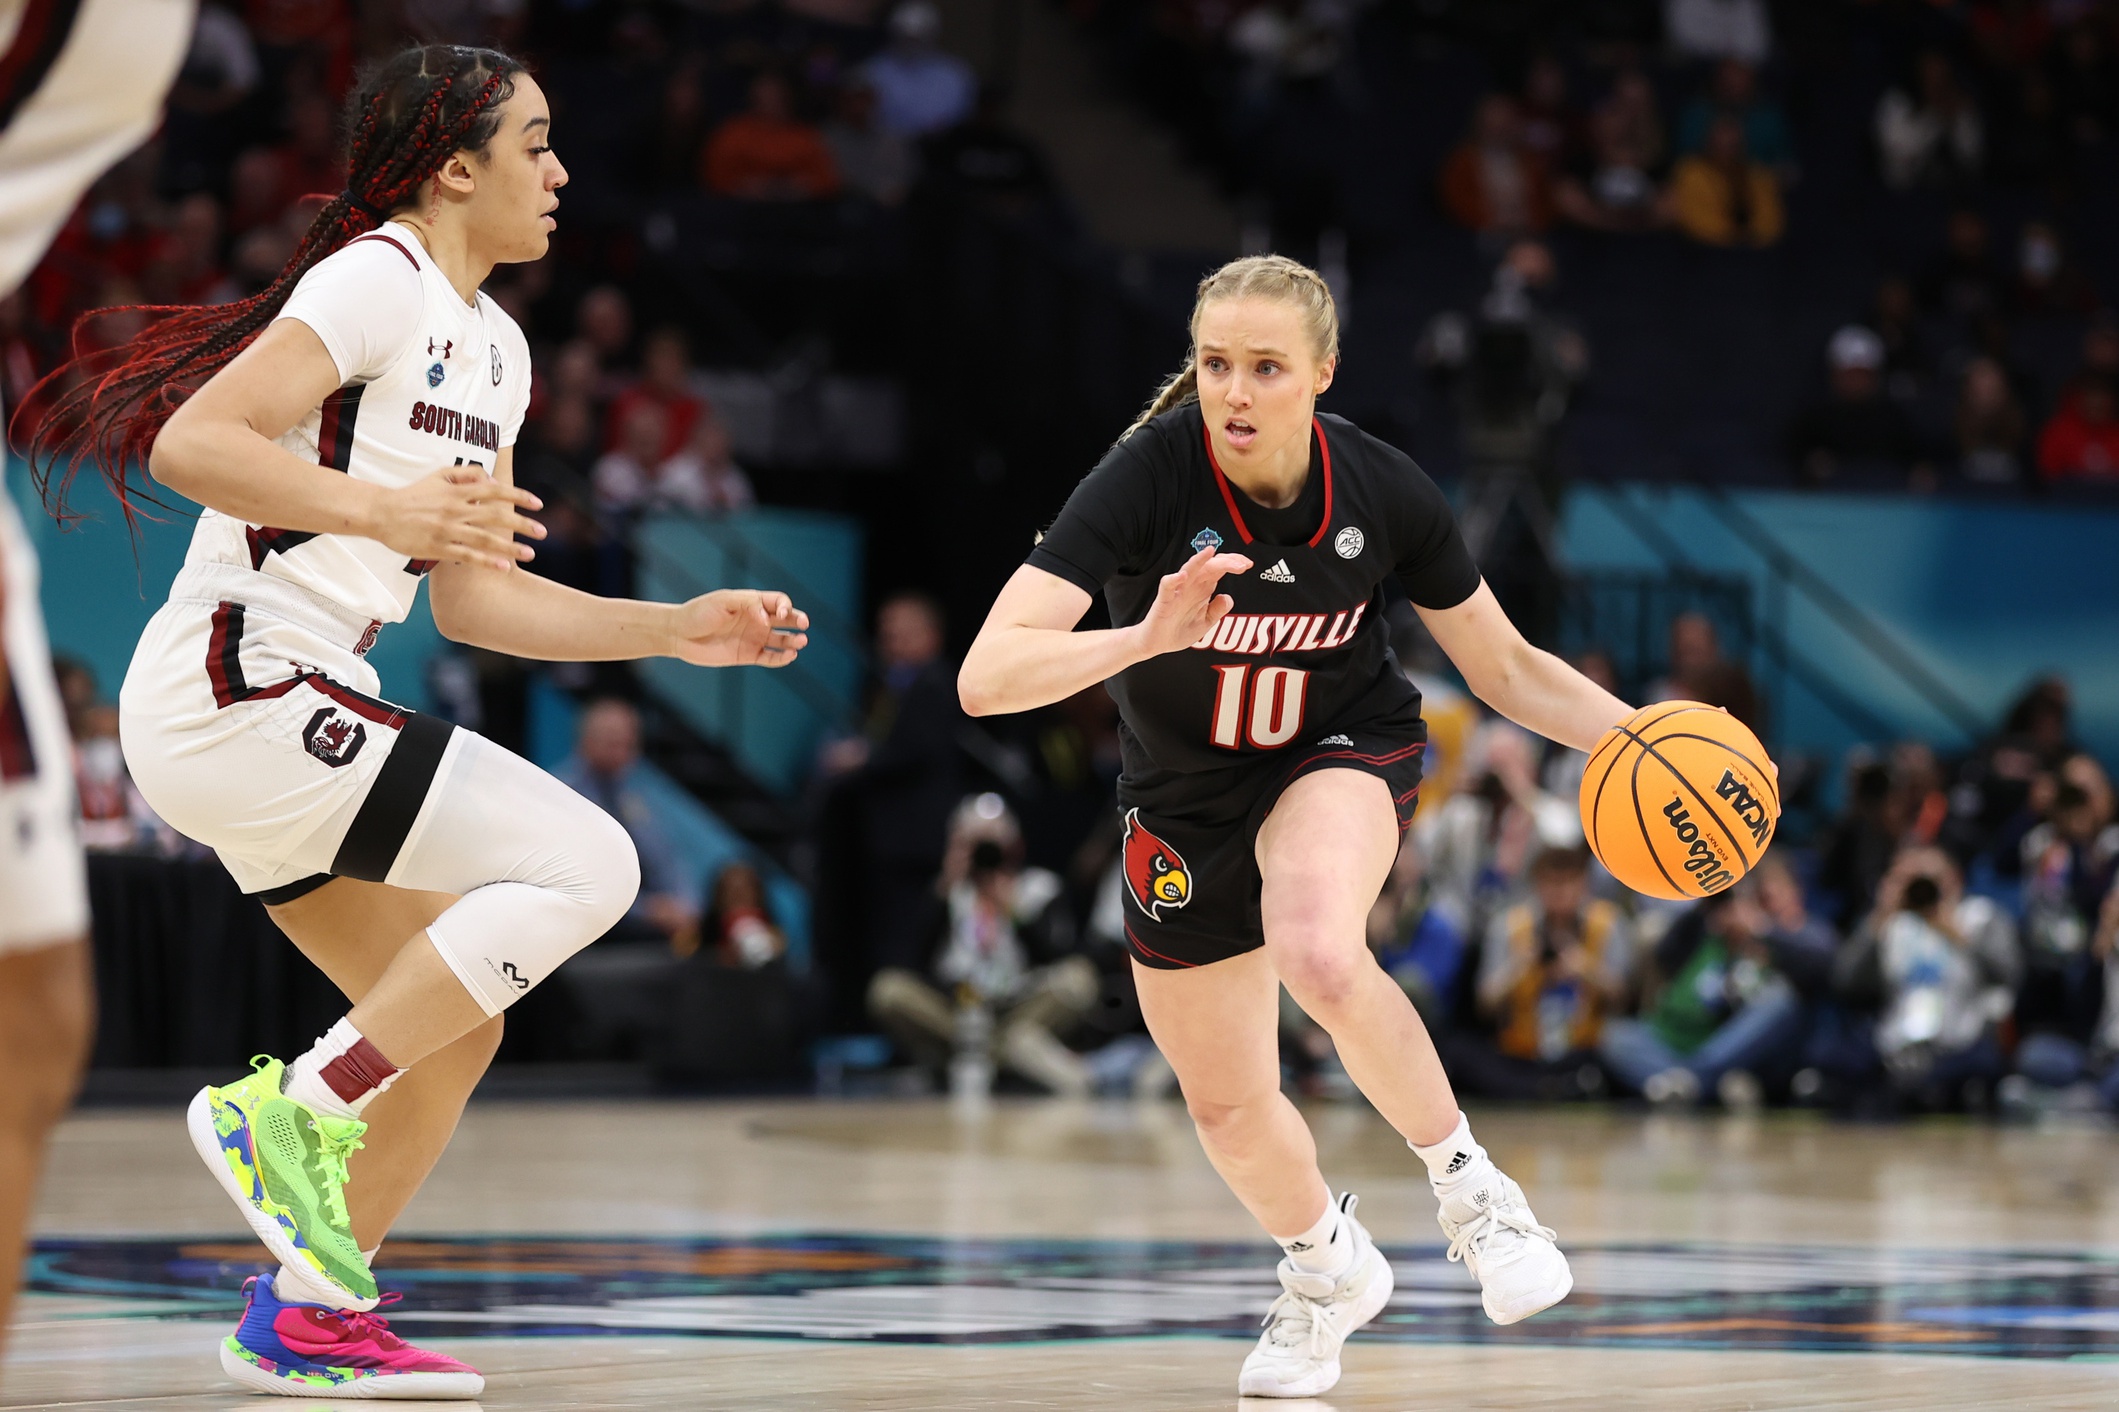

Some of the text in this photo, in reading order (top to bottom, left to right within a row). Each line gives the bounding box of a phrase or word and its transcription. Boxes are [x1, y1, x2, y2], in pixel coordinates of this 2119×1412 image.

[409, 400, 500, 453] SOUTH CAROLIN
[1340, 535, 1361, 546] ACC
[1260, 571, 1295, 583] adidas
[1210, 663, 1311, 750] 10
[1317, 737, 1354, 747] adidas
[1715, 767, 1771, 849] NCAA
[1663, 796, 1734, 893] Wilson
[1706, 833, 1719, 849] NXT
[1446, 1154, 1472, 1174] adidas
